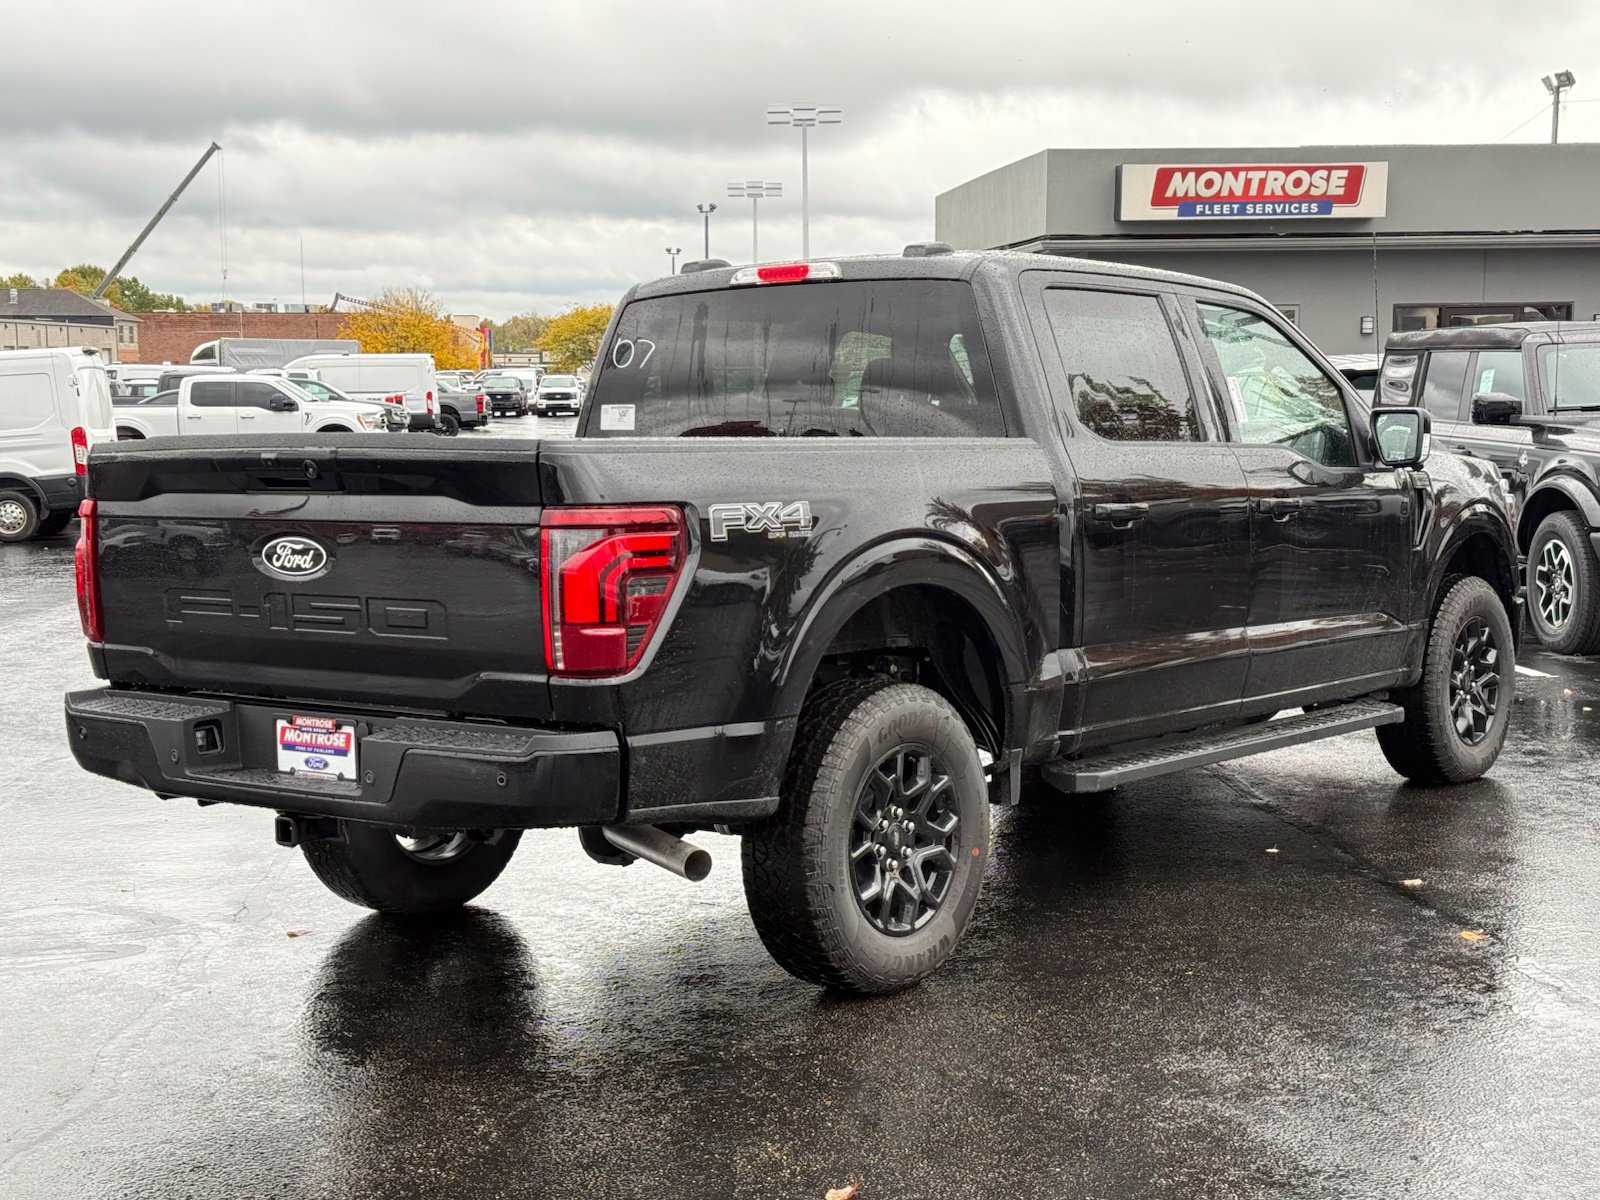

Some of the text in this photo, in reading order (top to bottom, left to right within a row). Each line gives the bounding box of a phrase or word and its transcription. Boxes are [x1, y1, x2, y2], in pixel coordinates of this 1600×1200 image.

[1165, 169, 1349, 198] MONTROSE
[1195, 202, 1319, 215] FLEET SERVICES
[612, 338, 656, 370] 07
[708, 501, 812, 542] FX4
[271, 541, 315, 569] Ford
[163, 586, 449, 641] F-150
[295, 717, 333, 728] MONTROSE
[284, 728, 347, 747] MONTROSE
[307, 757, 325, 769] Ford
